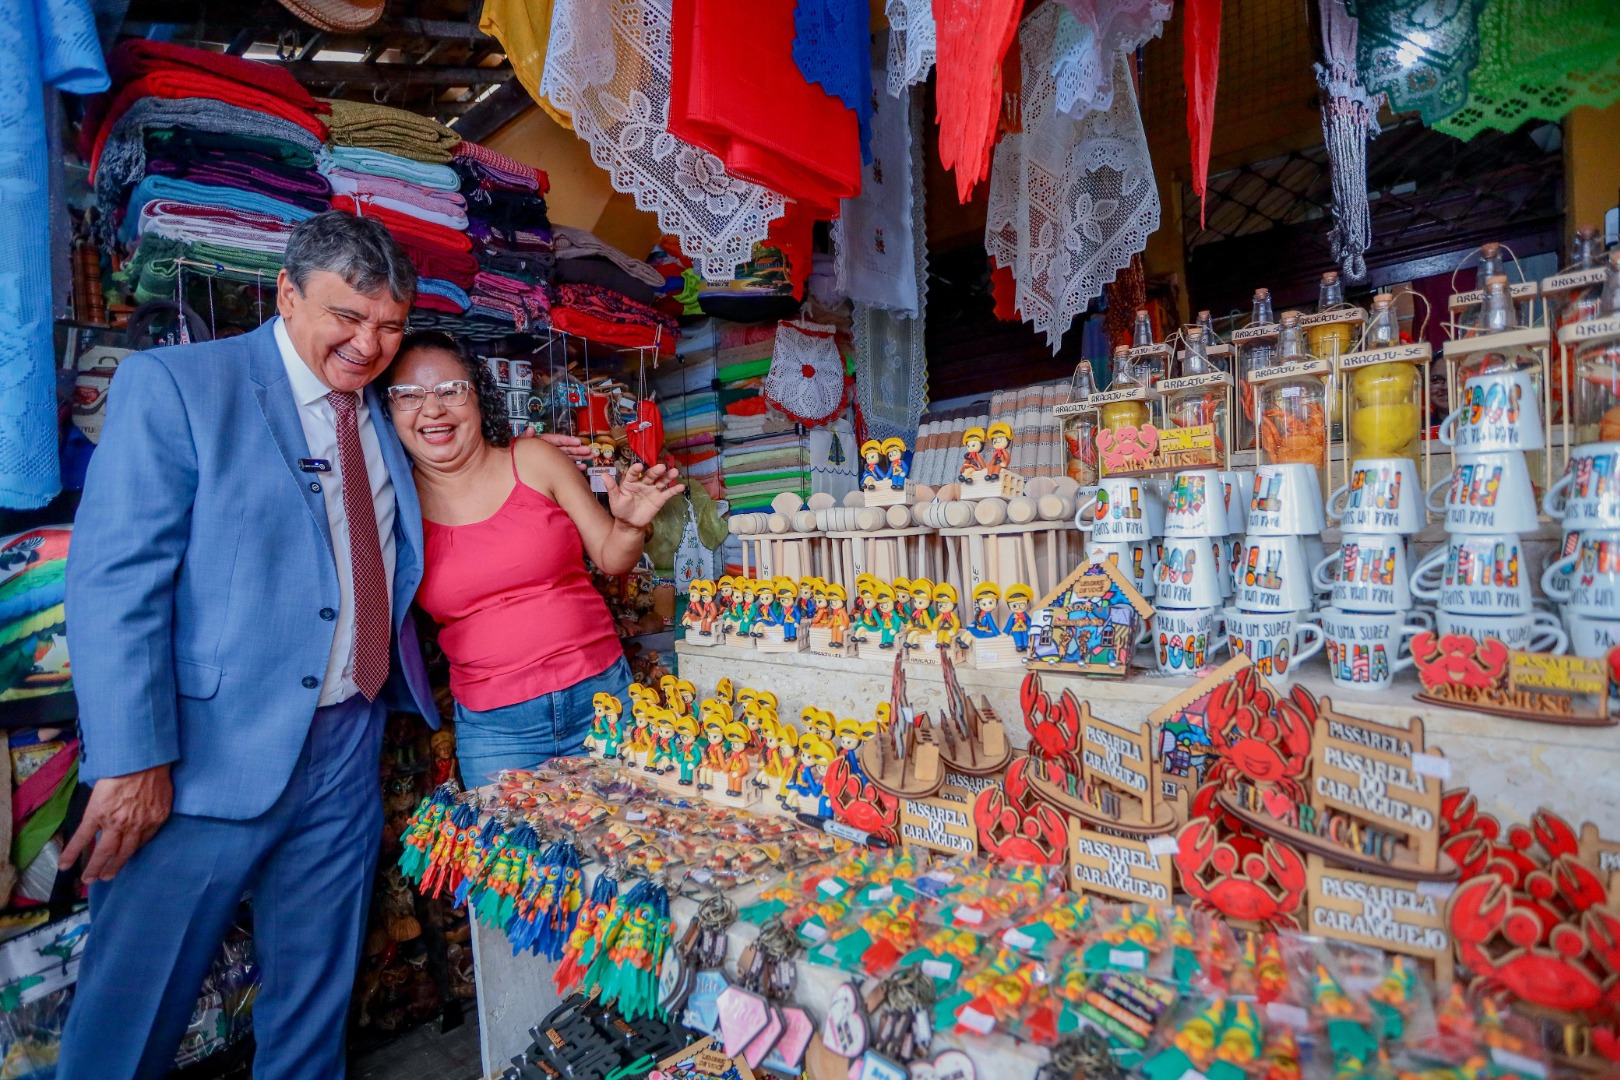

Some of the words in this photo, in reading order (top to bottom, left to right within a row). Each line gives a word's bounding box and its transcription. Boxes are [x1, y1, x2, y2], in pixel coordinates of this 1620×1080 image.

[1344, 347, 1424, 367] ARACAJU-SE
[1255, 361, 1320, 378] ARACAJU-SE
[1374, 510, 1399, 527] PARA
[1469, 509, 1495, 526] PARA
[1126, 521, 1143, 535] PARA
[1174, 586, 1192, 602] PARA
[1260, 591, 1280, 607] PARA
[1350, 586, 1368, 600] UMA
[1372, 588, 1394, 604] PARA
[1471, 590, 1492, 606] UMA
[1496, 591, 1520, 608] PARA
[1157, 615, 1175, 633] PARA
[1245, 622, 1260, 638] UM
[1264, 620, 1291, 638] SUPER
[1338, 625, 1355, 640] UMA
[1360, 624, 1390, 641] SUPER
[1085, 725, 1143, 762] PASSARELA
[1329, 721, 1413, 758] PASSARELA
[1105, 747, 1122, 766] DO
[1082, 750, 1149, 793] CARANGUEJO
[1324, 746, 1427, 795] PASSARELA
[1359, 773, 1387, 800] DO
[1316, 776, 1435, 832] CARANGUEJO
[906, 800, 969, 828] PASSARELA
[929, 817, 945, 834] DO
[902, 823, 974, 853] CARANGUEJO
[1078, 837, 1160, 872] PASSARELA
[1108, 857, 1130, 878] DO
[1074, 863, 1168, 901] CARANGUEJO
[1320, 876, 1438, 917] PASSARELA
[1362, 901, 1394, 924] DO
[1313, 907, 1448, 951] CARANGUEJO
